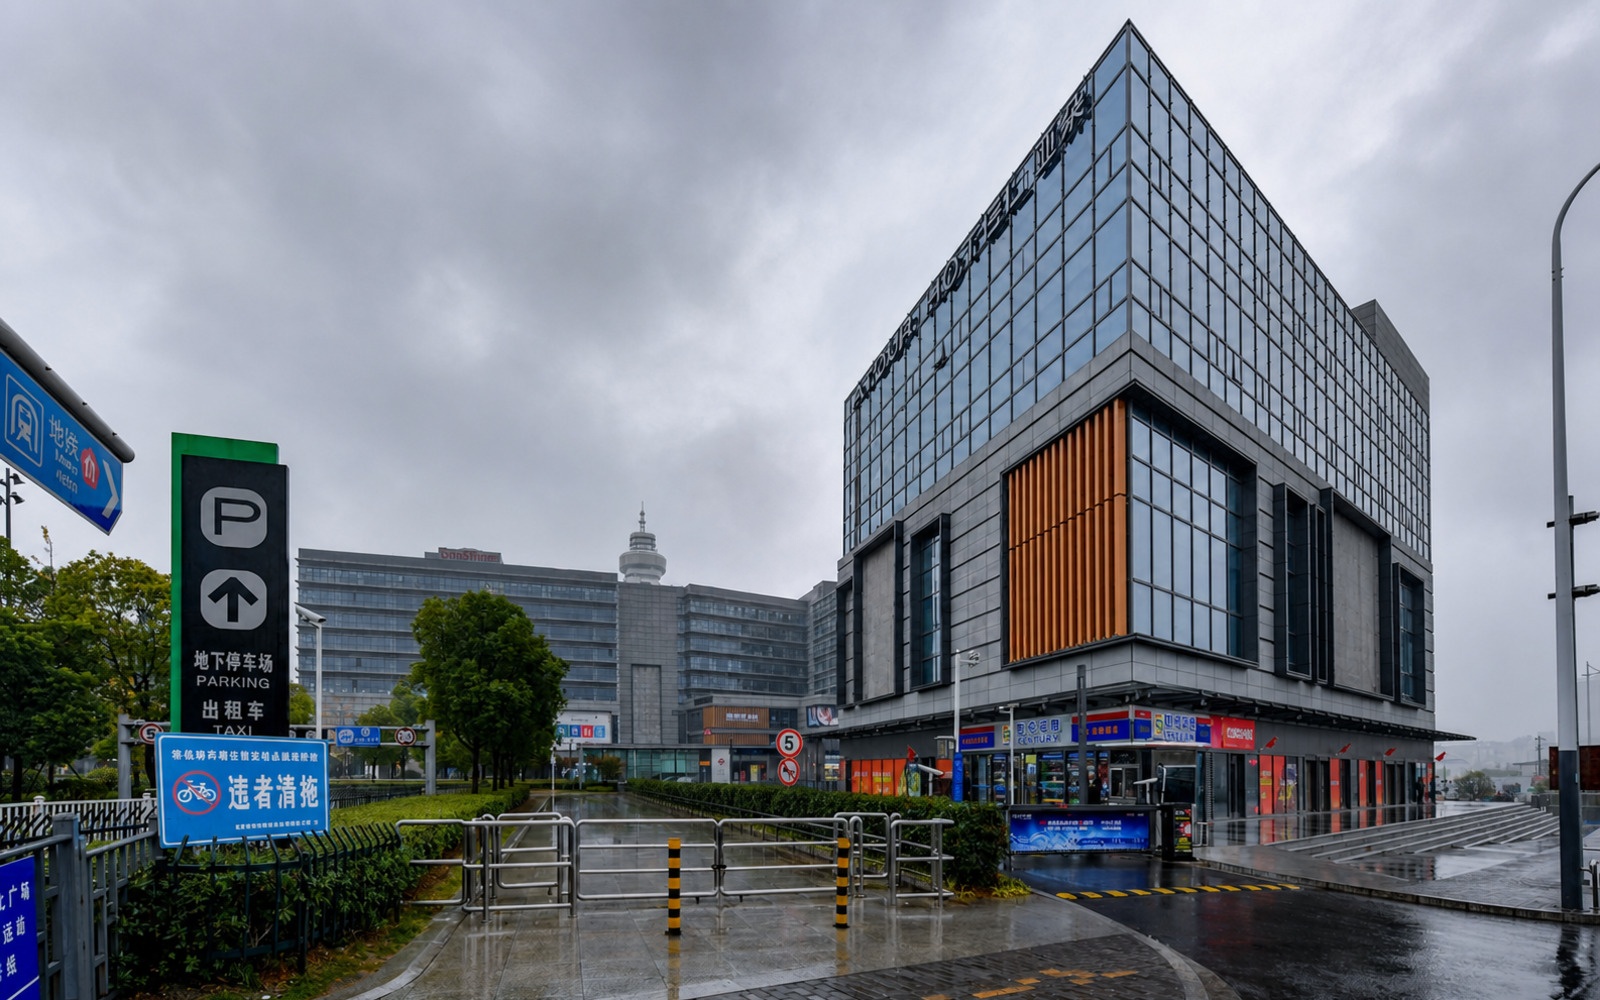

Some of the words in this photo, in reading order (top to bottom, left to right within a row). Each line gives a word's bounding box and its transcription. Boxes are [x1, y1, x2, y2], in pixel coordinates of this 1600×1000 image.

[214, 497, 261, 536] P
[194, 650, 273, 673] 地下停车场
[196, 675, 270, 689] PARKING
[202, 699, 264, 721] 出租车
[213, 725, 252, 736] TAXI
[784, 735, 794, 751] 5
